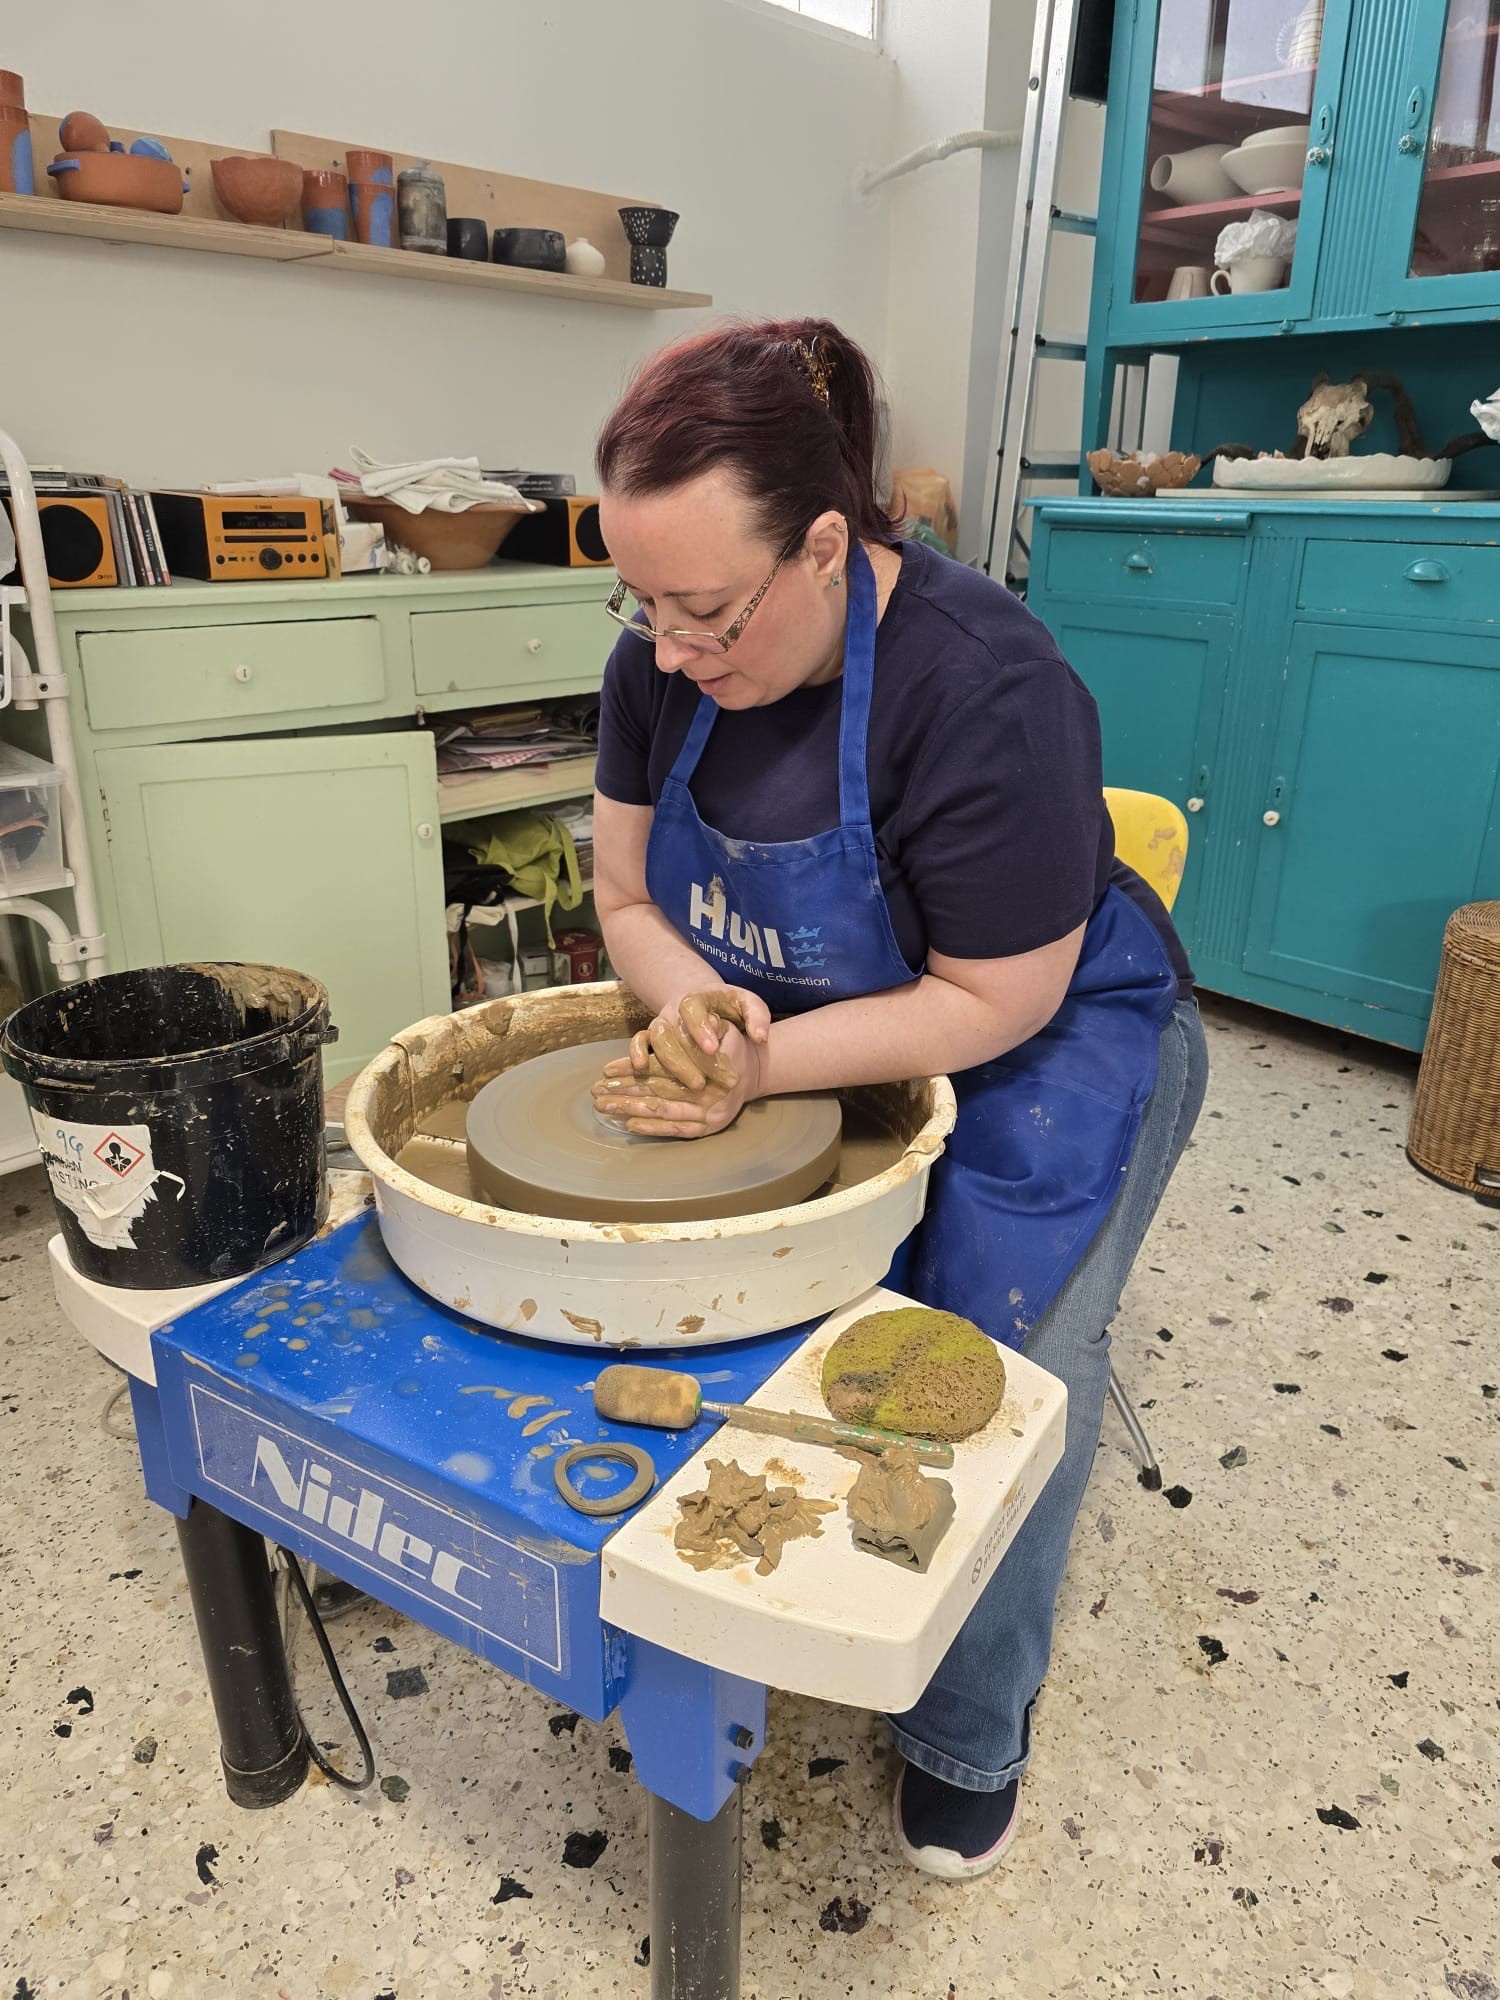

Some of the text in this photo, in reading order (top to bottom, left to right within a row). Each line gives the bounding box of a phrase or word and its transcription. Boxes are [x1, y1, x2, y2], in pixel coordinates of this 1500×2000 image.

[689, 881, 785, 969] Hull
[690, 931, 831, 987] Training & Adult Education
[251, 1435, 492, 1611] Nidec
